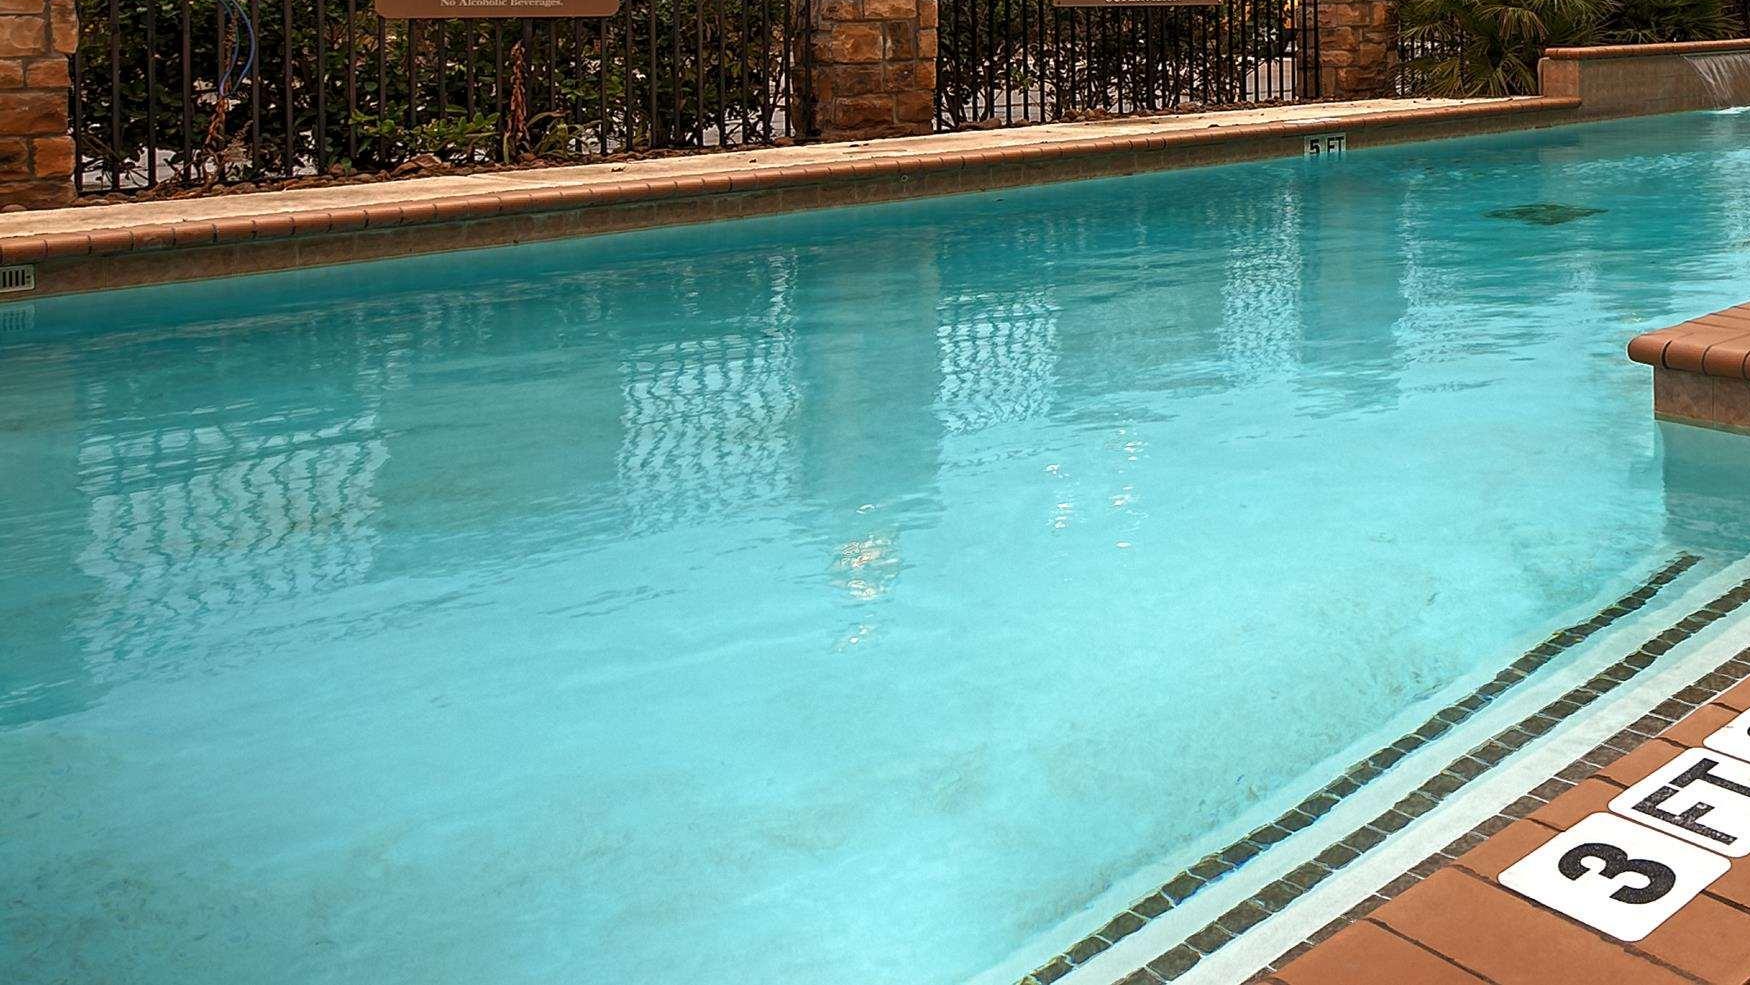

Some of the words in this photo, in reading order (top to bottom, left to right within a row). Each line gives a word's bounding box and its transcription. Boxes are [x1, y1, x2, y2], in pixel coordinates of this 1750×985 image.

[1309, 138, 1320, 155] 5
[1327, 136, 1345, 153] FT
[1557, 842, 1677, 905] 3
